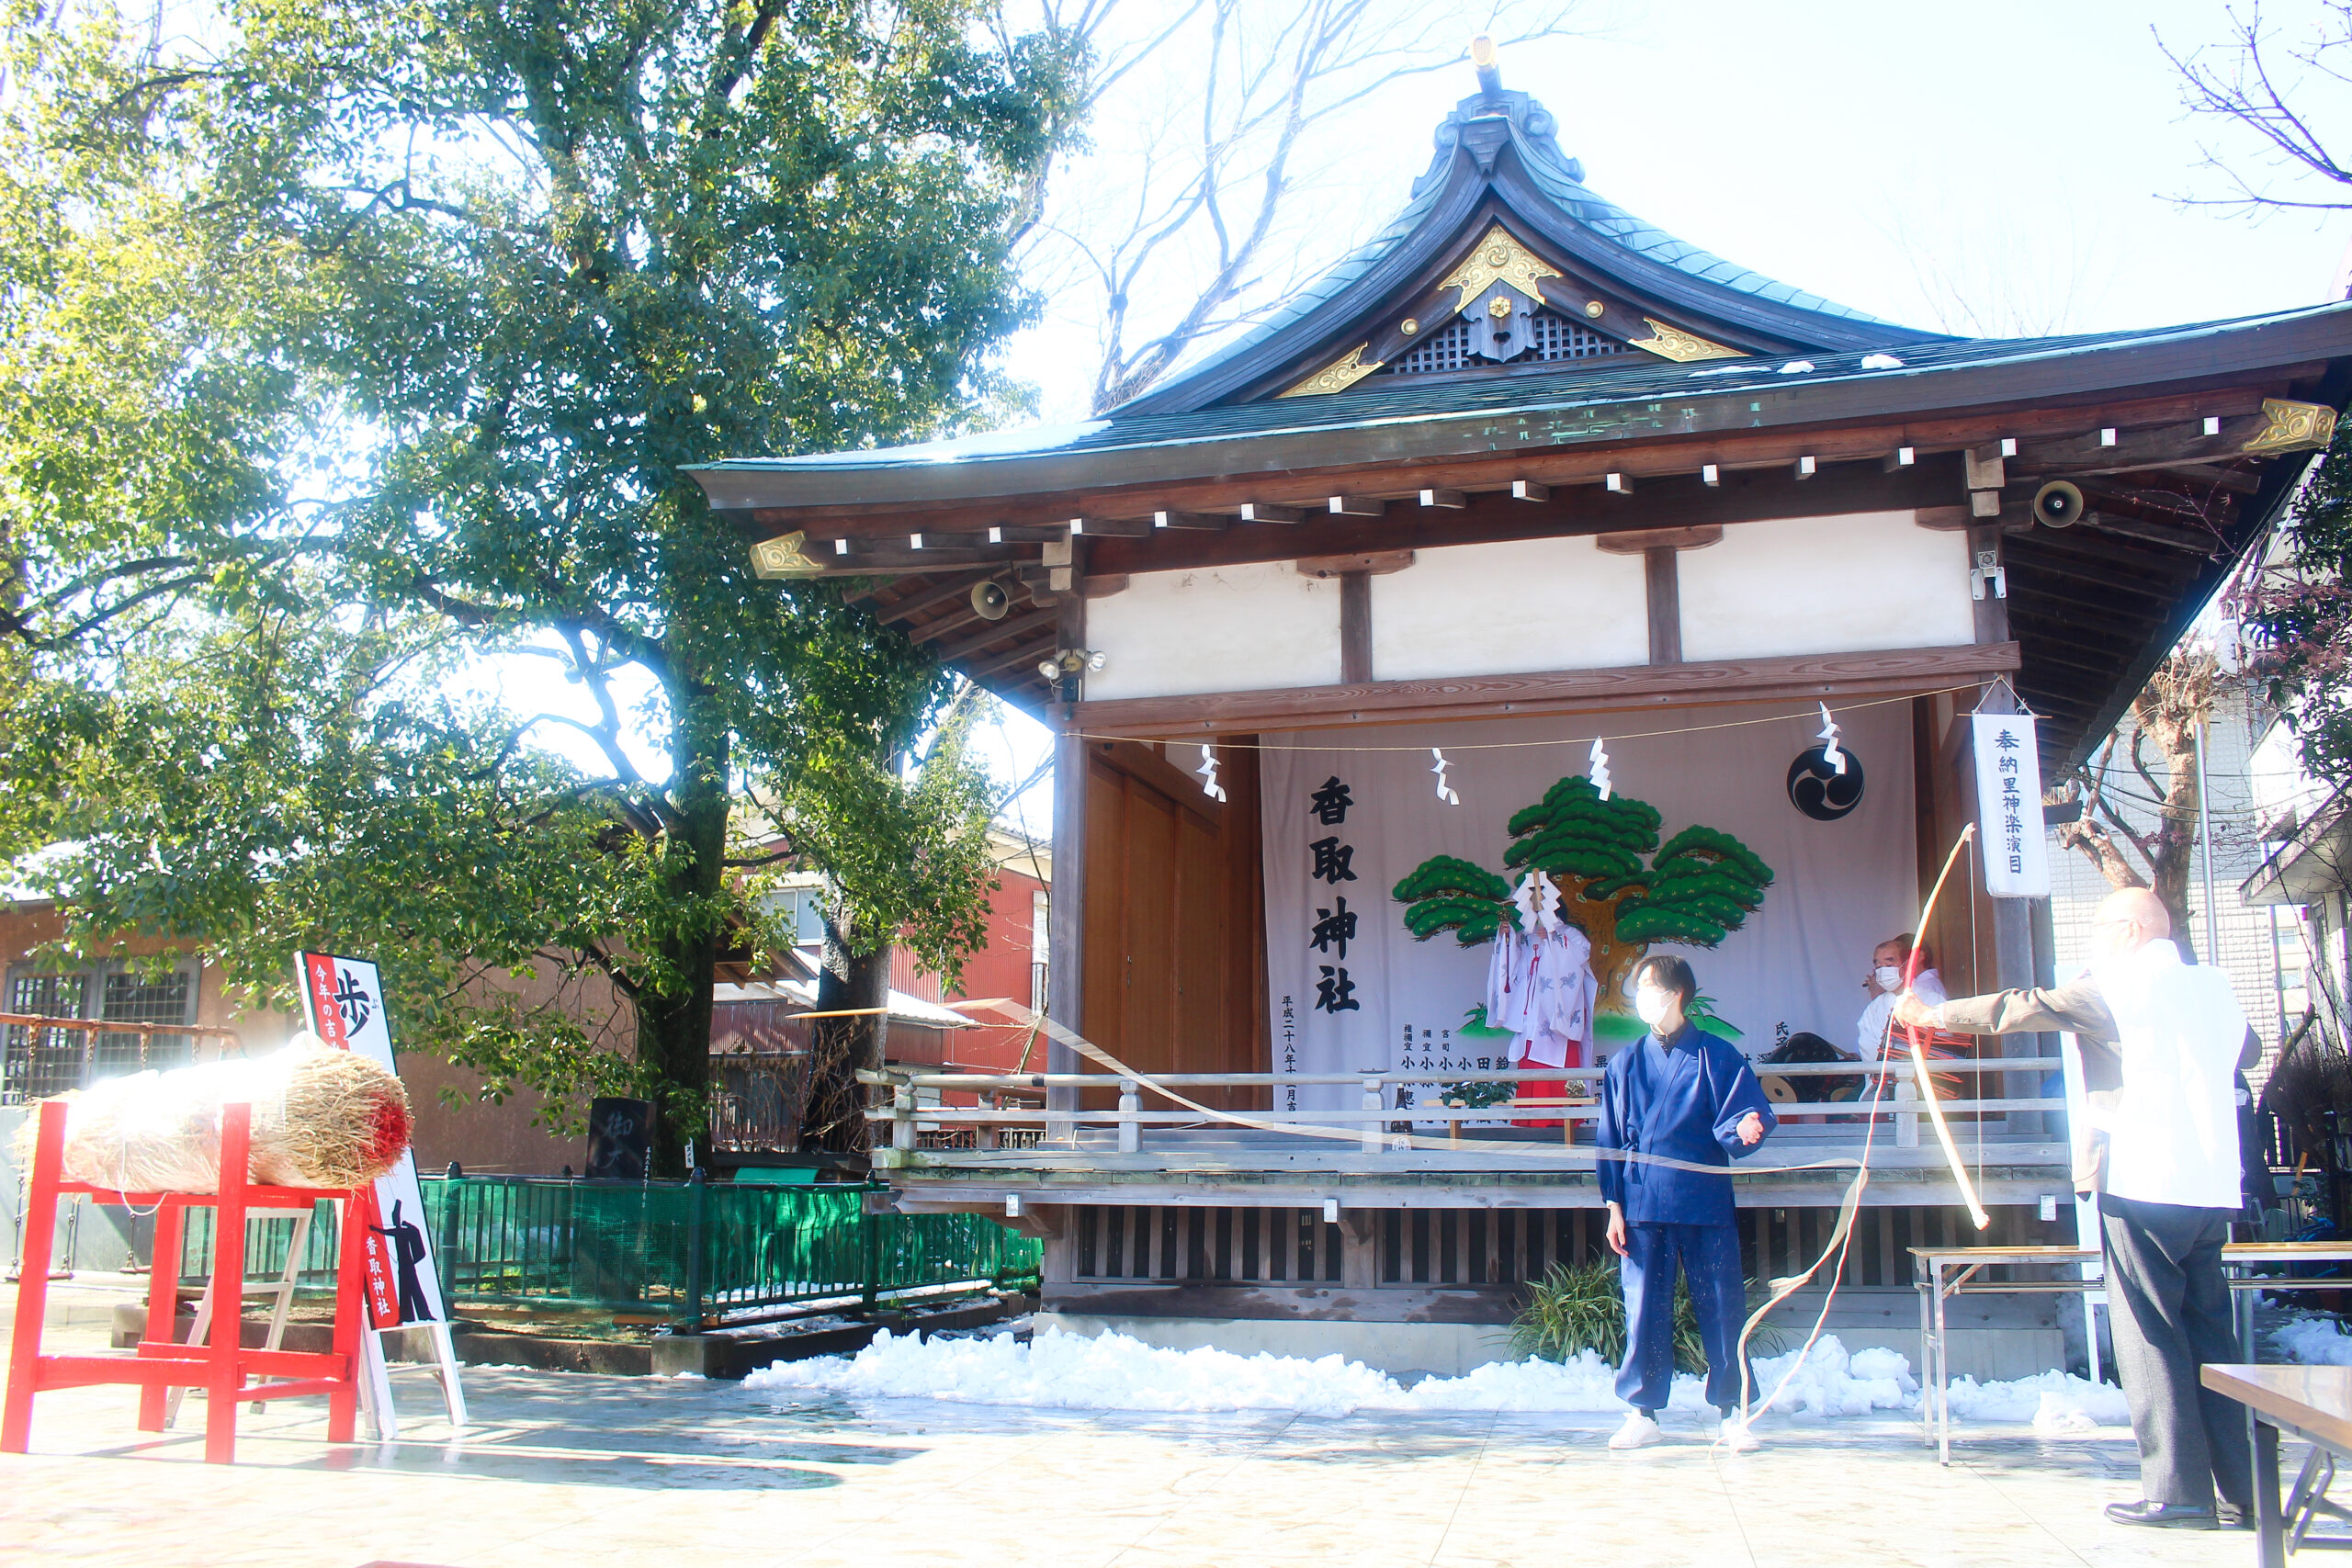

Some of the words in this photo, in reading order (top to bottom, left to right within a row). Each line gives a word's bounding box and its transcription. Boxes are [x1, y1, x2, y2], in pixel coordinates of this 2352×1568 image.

[1995, 728, 2022, 874] 奉納里神楽演目
[1309, 775, 1360, 1014] 香取神社
[333, 968, 369, 1039] 歩
[1442, 1030, 1450, 1052] 宮司
[367, 1235, 390, 1316] 香取神社
